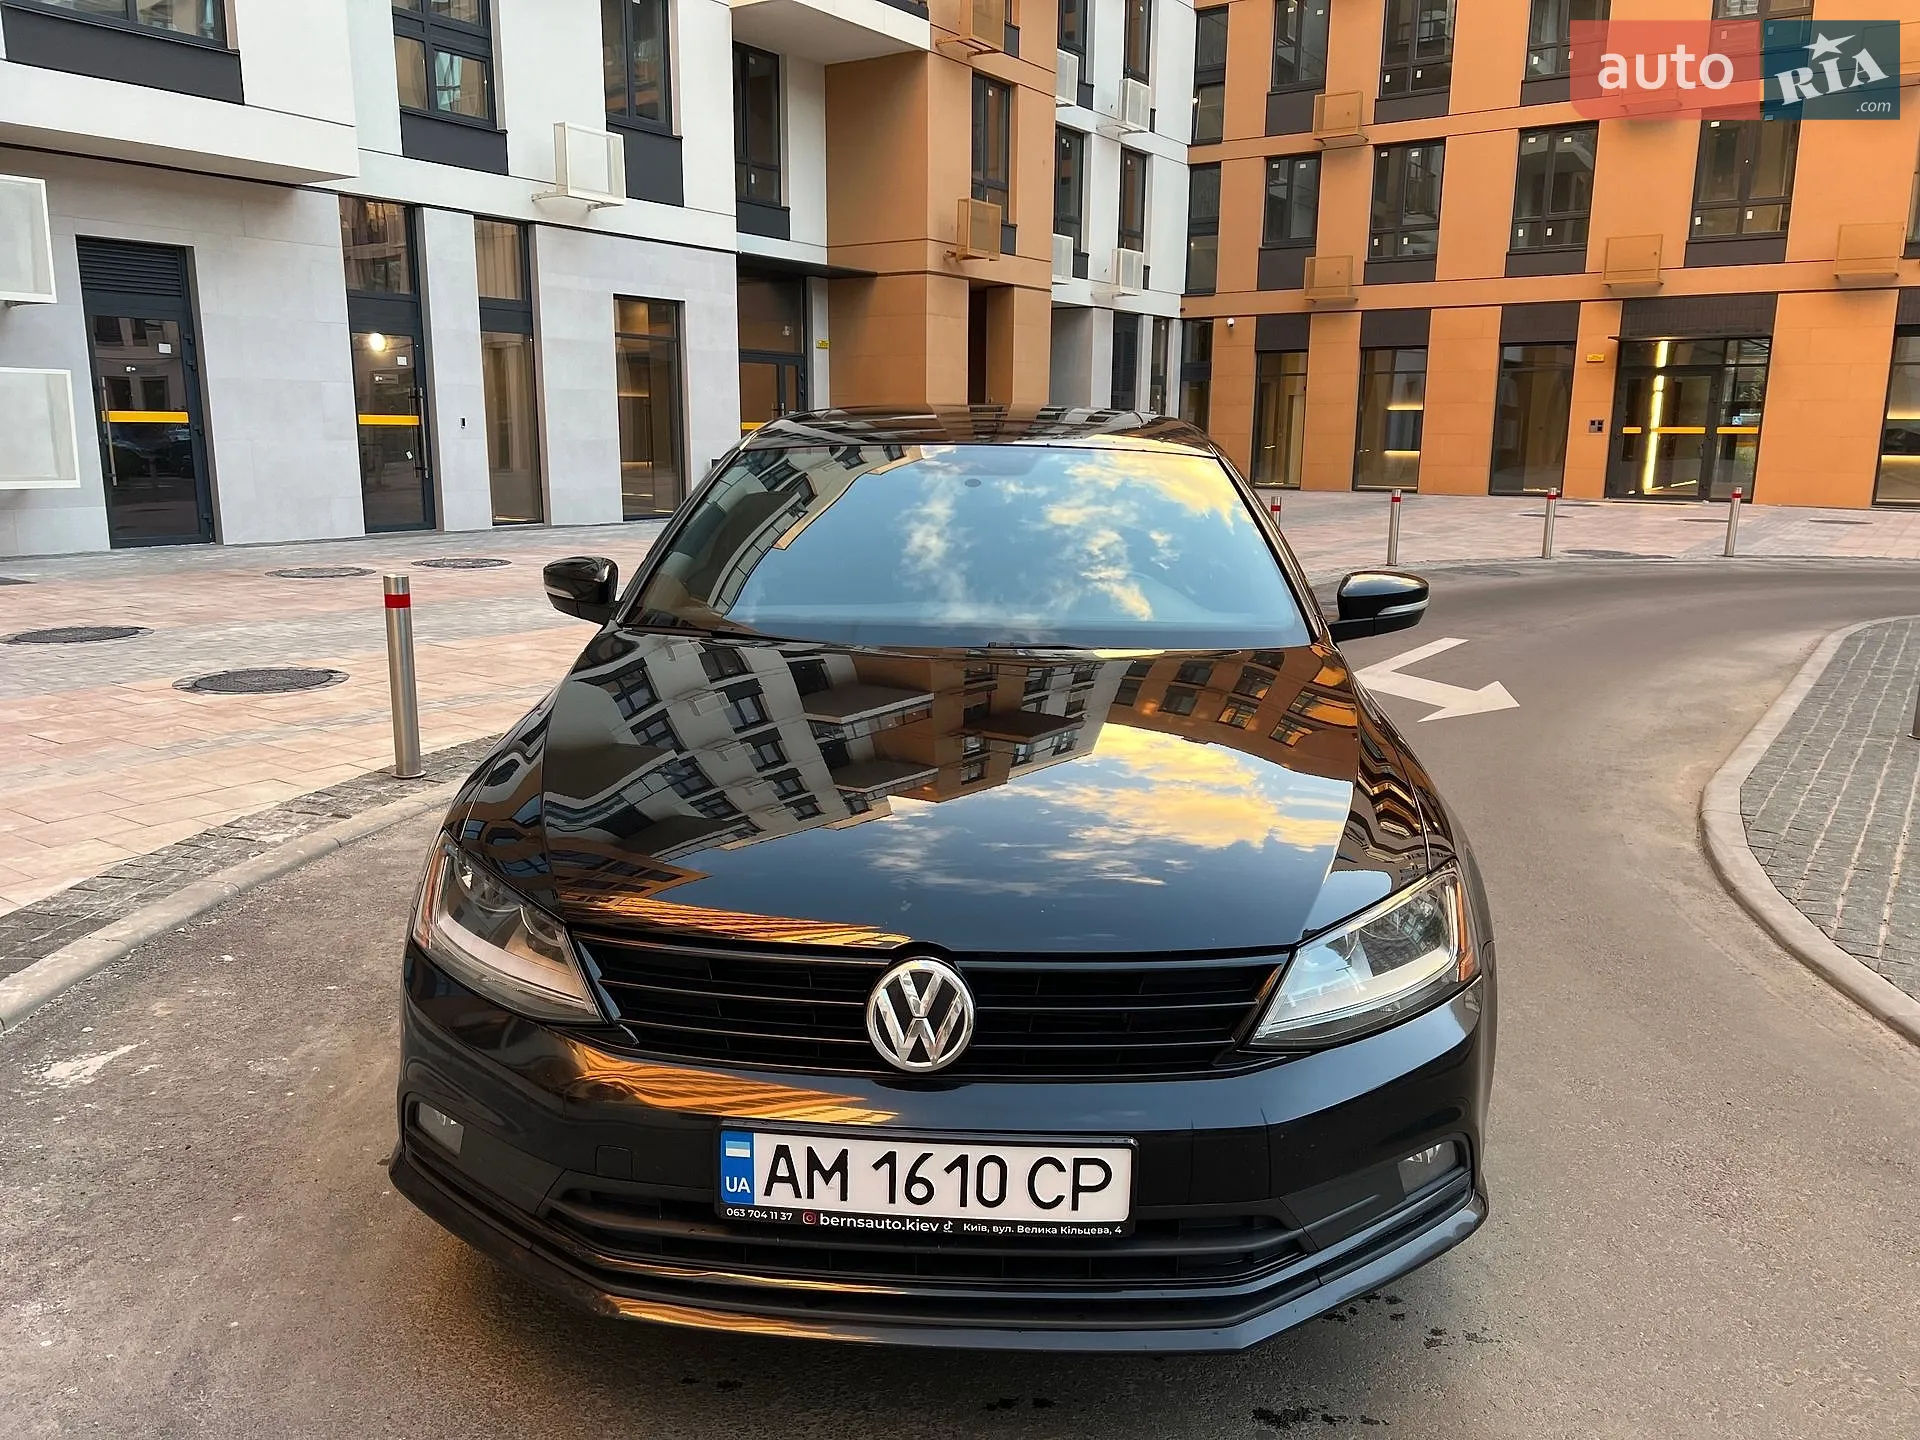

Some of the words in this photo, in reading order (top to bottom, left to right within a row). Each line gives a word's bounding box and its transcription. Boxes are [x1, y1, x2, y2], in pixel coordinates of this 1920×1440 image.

[725, 1176, 751, 1194] UA
[764, 1144, 849, 1202] AM
[872, 1150, 1008, 1208] 1610
[1027, 1156, 1113, 1212] CP
[726, 1208, 746, 1218] 063
[748, 1209, 768, 1220] 704
[770, 1211, 779, 1220] 11
[780, 1212, 793, 1221] 37
[819, 1212, 940, 1232] bernsauto.kiev
[963, 1223, 990, 1234] Київ,
[992, 1225, 1015, 1235] вул.
[1017, 1225, 1058, 1235] Велика
[1114, 1226, 1122, 1234] 4
